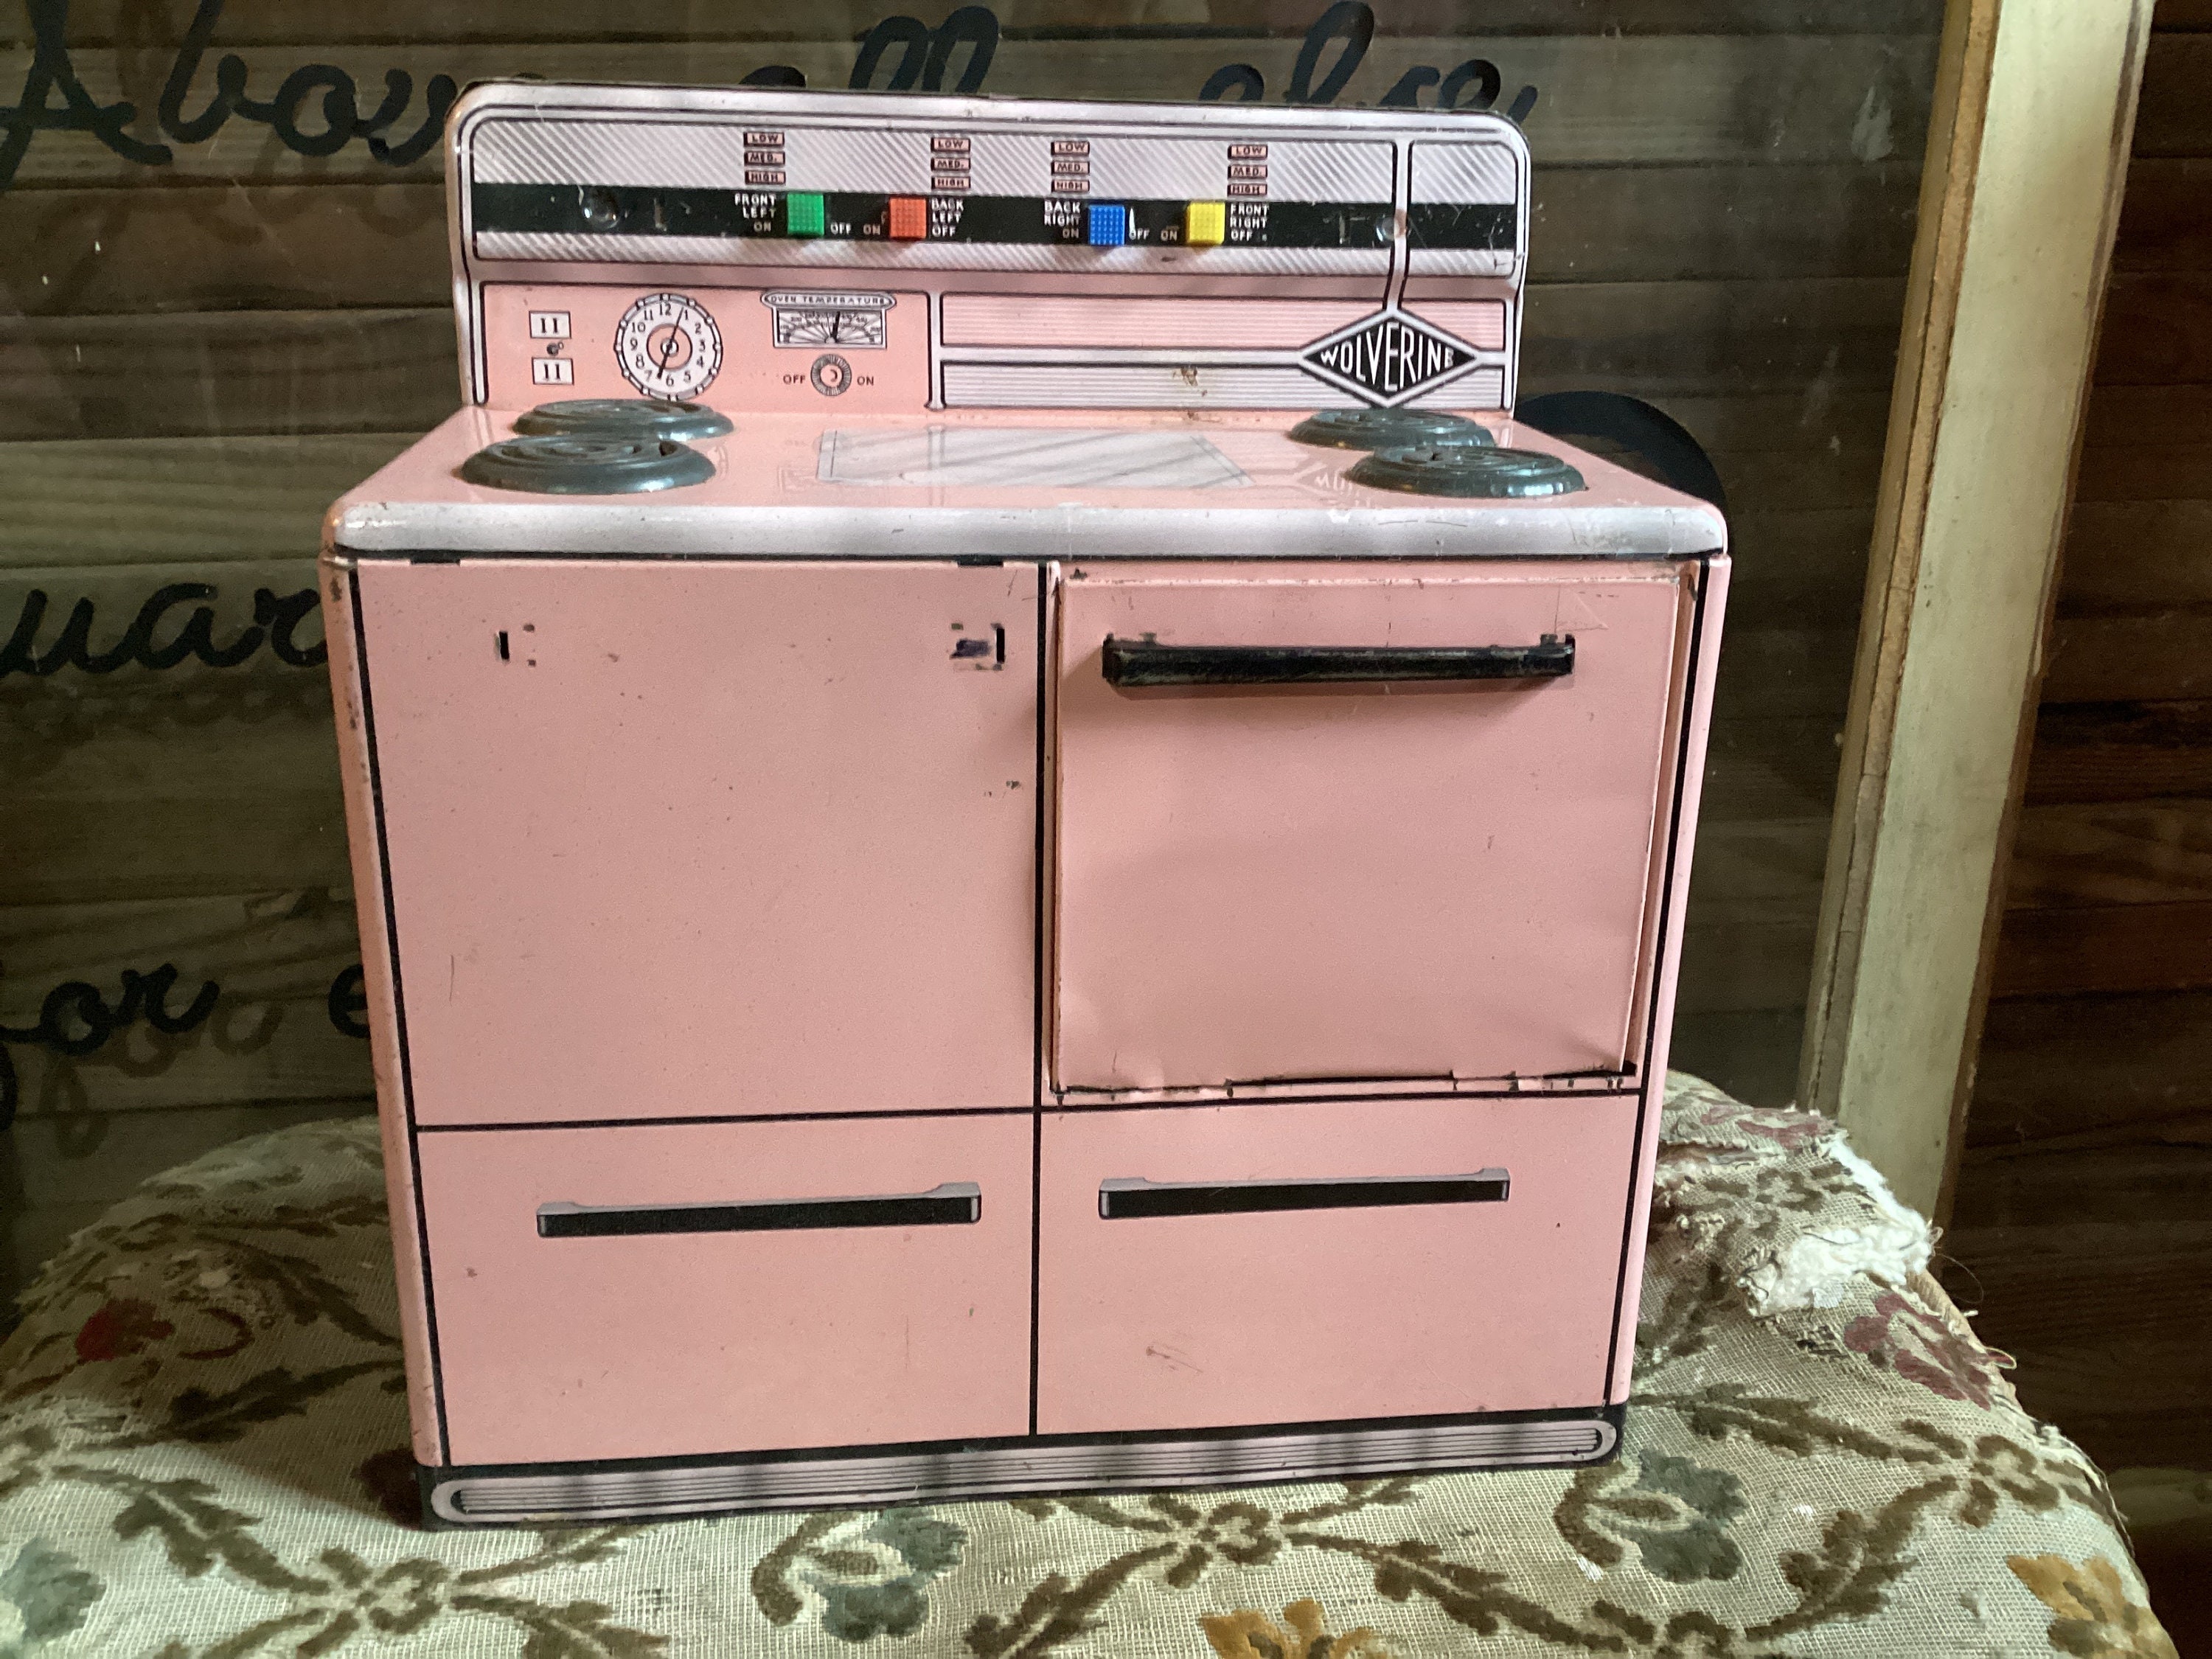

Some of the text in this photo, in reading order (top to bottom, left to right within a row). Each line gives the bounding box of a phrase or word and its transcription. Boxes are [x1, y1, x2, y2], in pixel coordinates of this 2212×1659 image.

[752, 135, 778, 143] LOW
[1059, 143, 1085, 152] LOW
[1236, 147, 1263, 156] LOW
[937, 160, 964, 168] MED.
[1057, 164, 1084, 172] MED.
[751, 173, 779, 182] HIGH
[937, 179, 964, 187] HIGH
[1057, 182, 1082, 190] HIGH
[1232, 186, 1260, 195] HIGH
[734, 192, 776, 206] FRONT
[931, 198, 964, 211] BACK
[1044, 200, 1081, 213] BACK
[1230, 203, 1269, 215] FRONT
[742, 206, 776, 220] LEFT
[932, 211, 961, 223] LEFT
[1044, 213, 1081, 226] RIGHT
[1230, 217, 1268, 229] RIGHT
[754, 222, 771, 232] ON
[830, 223, 852, 235] OFF
[863, 223, 881, 235] ON
[931, 225, 956, 237] OFF
[1062, 228, 1079, 239] ON
[1129, 228, 1150, 240] OFF
[1161, 229, 1178, 242] ON
[1231, 231, 1253, 242] OFF
[644, 309, 653, 321] 11
[659, 302, 672, 316] 12
[631, 321, 646, 333] 10
[695, 322, 702, 334] 2
[630, 337, 638, 351] 9
[699, 339, 706, 352] 3
[636, 354, 645, 369] 8
[697, 355, 704, 367] 4
[1320, 321, 1455, 392] WOLVERINE
[644, 369, 653, 382] 7
[666, 374, 675, 387] 6
[683, 370, 692, 383] 5
[782, 375, 806, 385] OFF
[857, 375, 874, 386] ON
